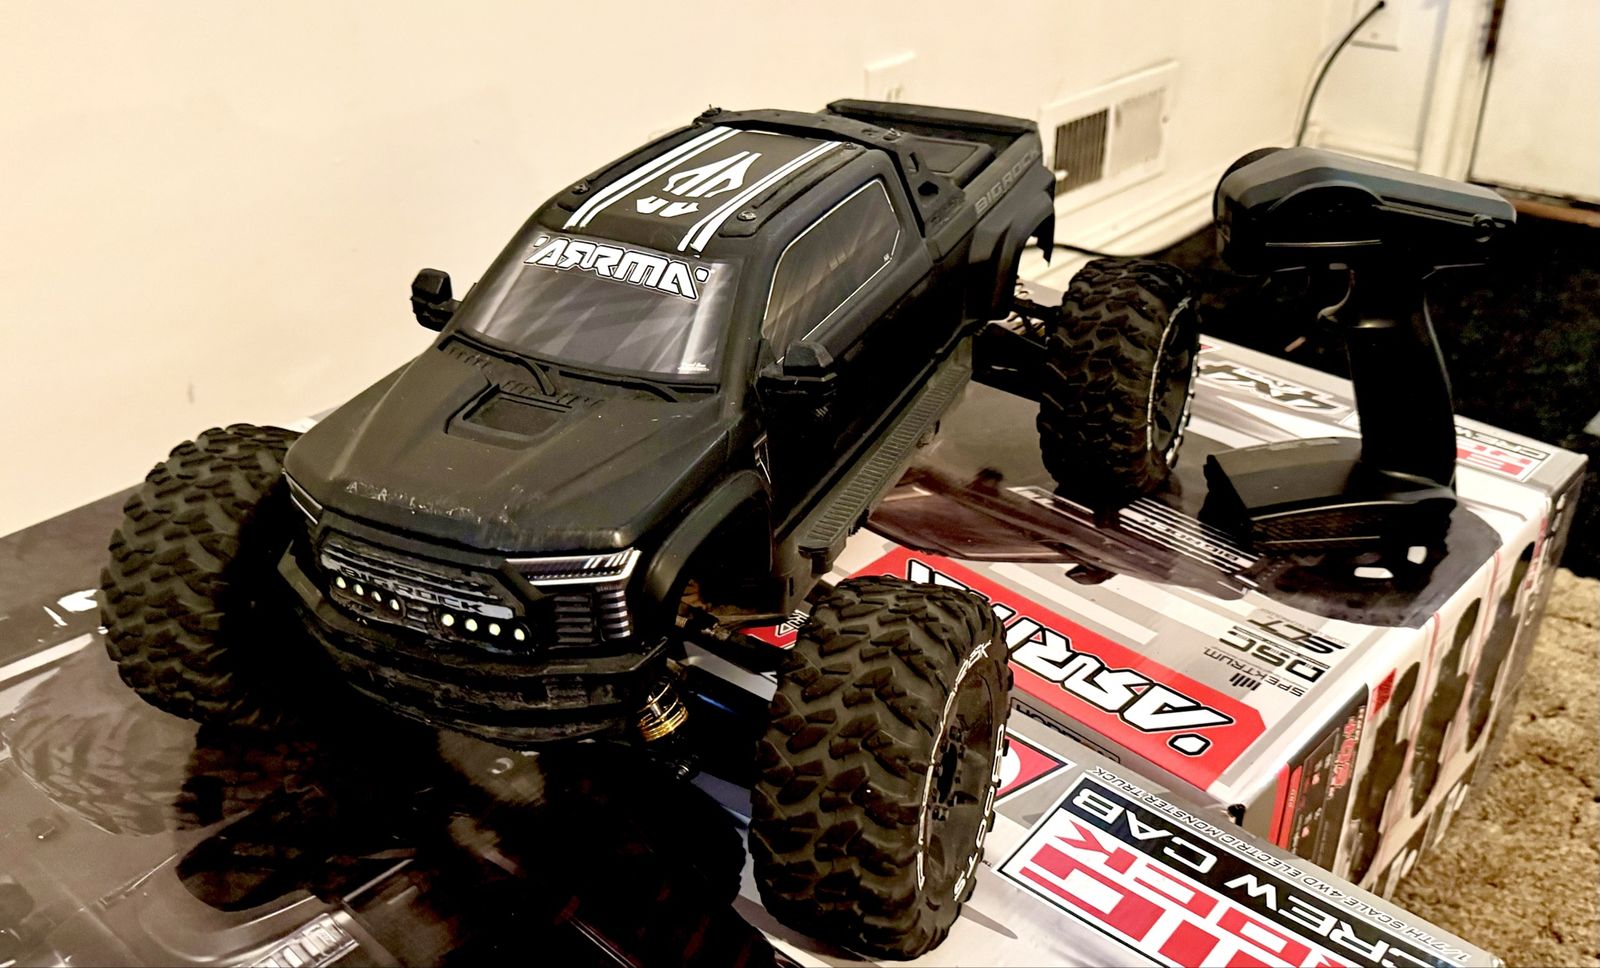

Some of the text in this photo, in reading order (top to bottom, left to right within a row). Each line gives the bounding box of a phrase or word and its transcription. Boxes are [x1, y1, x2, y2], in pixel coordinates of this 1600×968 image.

[975, 181, 1005, 217] BIG
[524, 236, 700, 303] ARRMA
[393, 581, 483, 613] ROCK
[907, 558, 1236, 734] ARR
[1219, 629, 1326, 683] DSC
[1204, 648, 1305, 698] SPEKTRUM
[1092, 766, 1146, 800] TRUCK
[1073, 788, 1218, 874] CAB
[1145, 794, 1220, 837] MONSTER
[1220, 835, 1302, 878] ELECTRIC
[1019, 843, 1274, 968] IG
[1303, 877, 1343, 900] 4WD
[1344, 898, 1408, 930] SCALE
[1405, 928, 1470, 961] 1/7TH
